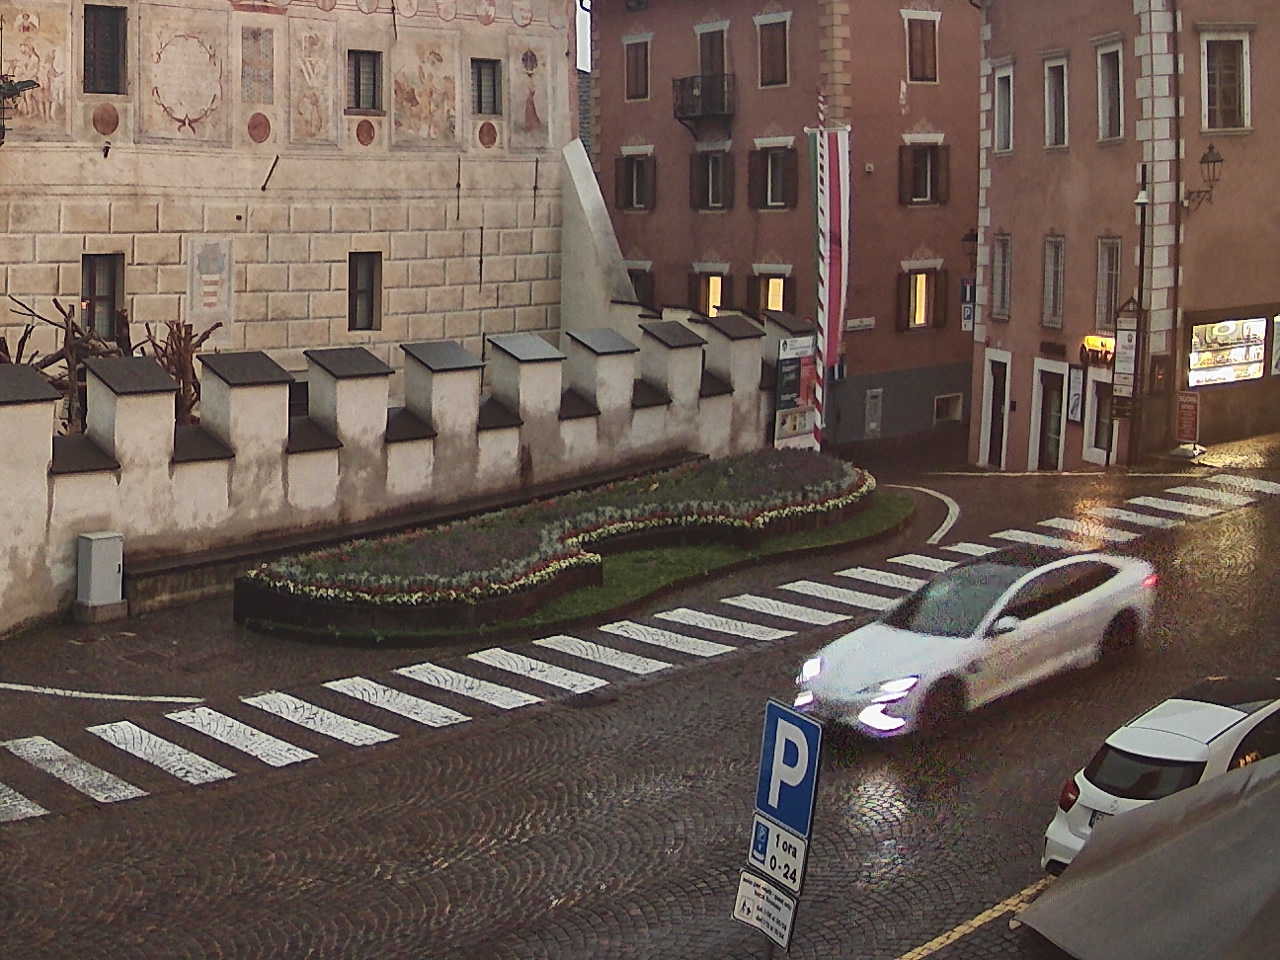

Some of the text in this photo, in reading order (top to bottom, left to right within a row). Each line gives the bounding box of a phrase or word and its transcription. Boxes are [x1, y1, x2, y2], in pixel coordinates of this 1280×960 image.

[767, 717, 809, 809] P
[775, 833, 797, 859] 1 ora
